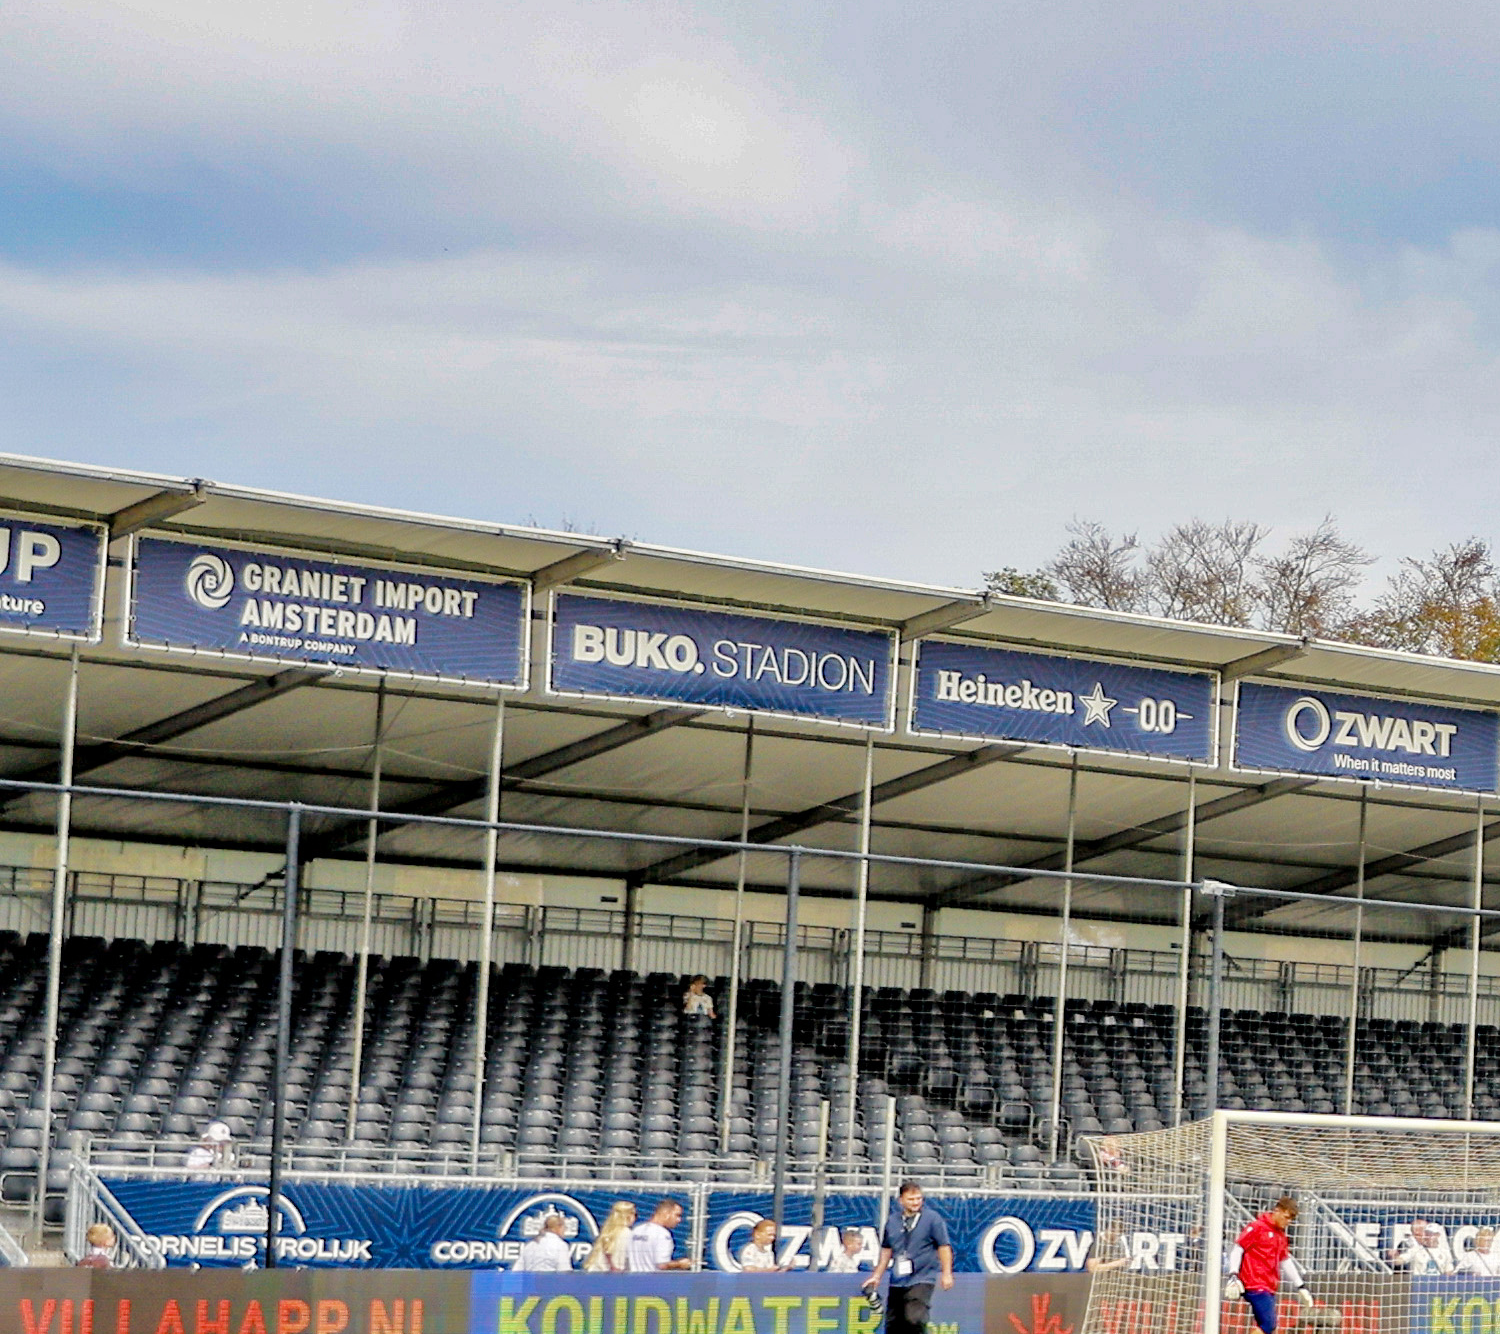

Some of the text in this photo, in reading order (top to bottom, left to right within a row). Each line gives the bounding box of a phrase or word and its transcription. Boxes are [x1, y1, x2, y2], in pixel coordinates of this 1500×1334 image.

[243, 563, 478, 617] GRANIET IMPORT
[240, 633, 356, 656] A BONTRUP COMPANY
[241, 598, 417, 645] AMSTERDAM
[712, 640, 876, 695] STADION
[937, 670, 1075, 715] Heineken
[1334, 754, 1456, 780] When it matters most
